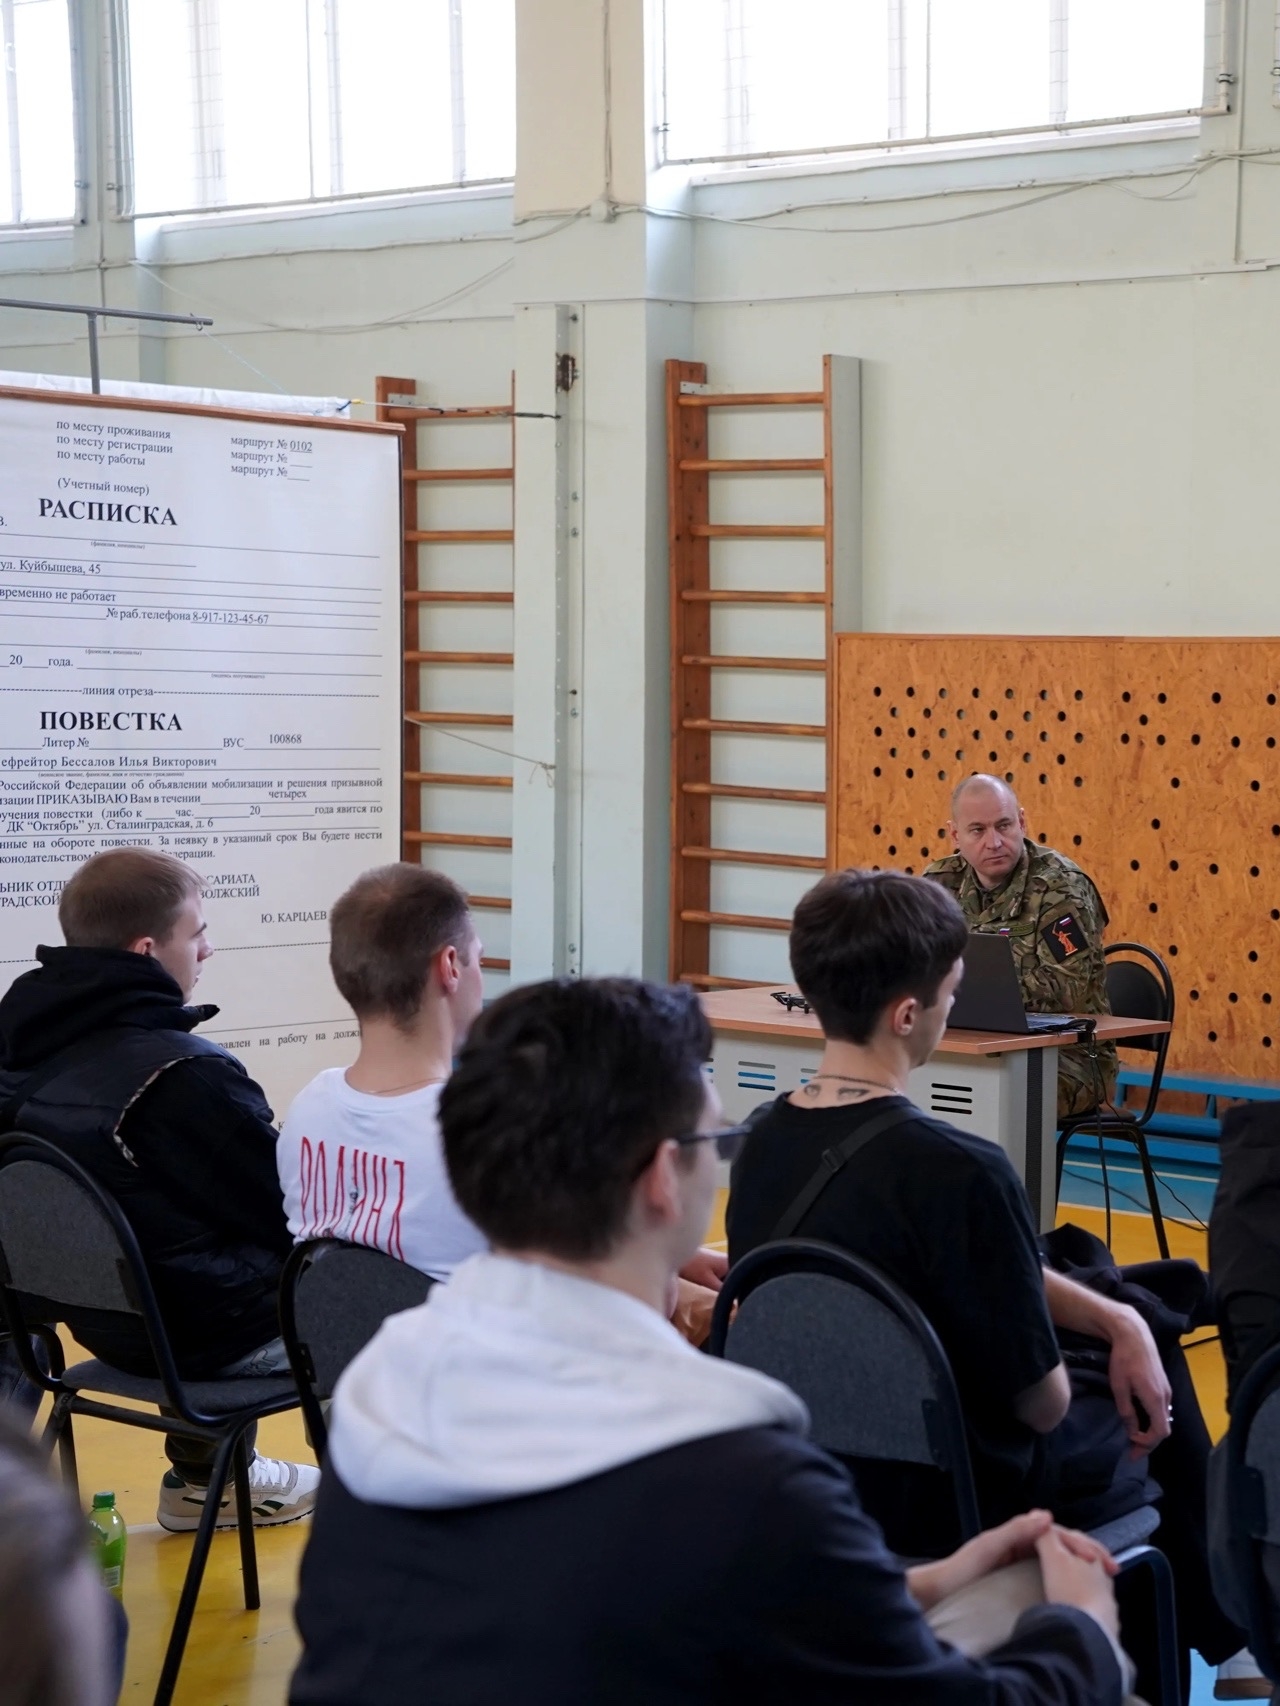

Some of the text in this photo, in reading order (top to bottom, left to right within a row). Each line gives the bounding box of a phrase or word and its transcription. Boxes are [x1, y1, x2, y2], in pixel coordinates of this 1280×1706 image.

[56, 421, 172, 440] по месту проживания
[56, 435, 174, 454] по месту регистрации
[230, 437, 313, 453] маршрут № 0102
[57, 450, 146, 466] по месту работы
[230, 450, 288, 465] маршрут №
[230, 464, 288, 479] маршрут №
[57, 477, 150, 497] (Учетный номер)
[38, 497, 179, 527] РАСПИСКА
[0, 559, 102, 575] ул. Куйбышева, 45
[0, 588, 117, 603] временно не работает
[105, 607, 119, 619] №
[192, 612, 269, 625] 8-917-123-45-67
[9, 654, 74, 668] 20 года.
[82, 686, 154, 699] линия отреза
[39, 710, 184, 732] ПОВЕСТКА
[41, 733, 303, 751] Литер № ВУС 100868
[1, 755, 217, 769] ефрейтор Бессалов Илья Викторович
[65, 779, 127, 793] Федерации
[131, 779, 145, 790] об
[148, 778, 208, 791] объявлении
[211, 777, 273, 790] мобилизации
[276, 779, 283, 789] и
[286, 779, 328, 790] решения
[331, 777, 383, 789] призывной
[36, 793, 129, 805] ПРИКАЗЫВАЮ
[129, 793, 152, 804] Вам
[153, 796, 160, 804] в
[161, 794, 202, 804] течении
[268, 789, 307, 801] четырех
[0, 804, 383, 823] учения повестки (либо к час. 20 года явится по
[6, 820, 25, 834] ДК
[87, 822, 103, 832] ул.
[106, 818, 193, 832] Сталинградская,
[194, 821, 205, 830] д.
[206, 817, 214, 829] 6
[33, 839, 46, 849] на
[50, 836, 96, 851] обороте
[100, 838, 153, 848] повестки.
[157, 835, 170, 846] За
[174, 836, 209, 848] неявку
[212, 836, 219, 845] в
[222, 832, 272, 847] указанный
[275, 834, 298, 845] срок
[301, 832, 318, 842] Вы
[320, 829, 351, 844] будете
[354, 830, 383, 841] нести
[37, 880, 69, 892] ОТД
[204, 873, 256, 886] САРИАТА
[0, 892, 60, 908] РАДСКОЙ
[260, 910, 328, 925] Ю. КАРЦАЕВ
[259, 1037, 270, 1047] на
[277, 1033, 308, 1047] работу
[315, 1032, 327, 1042] на
